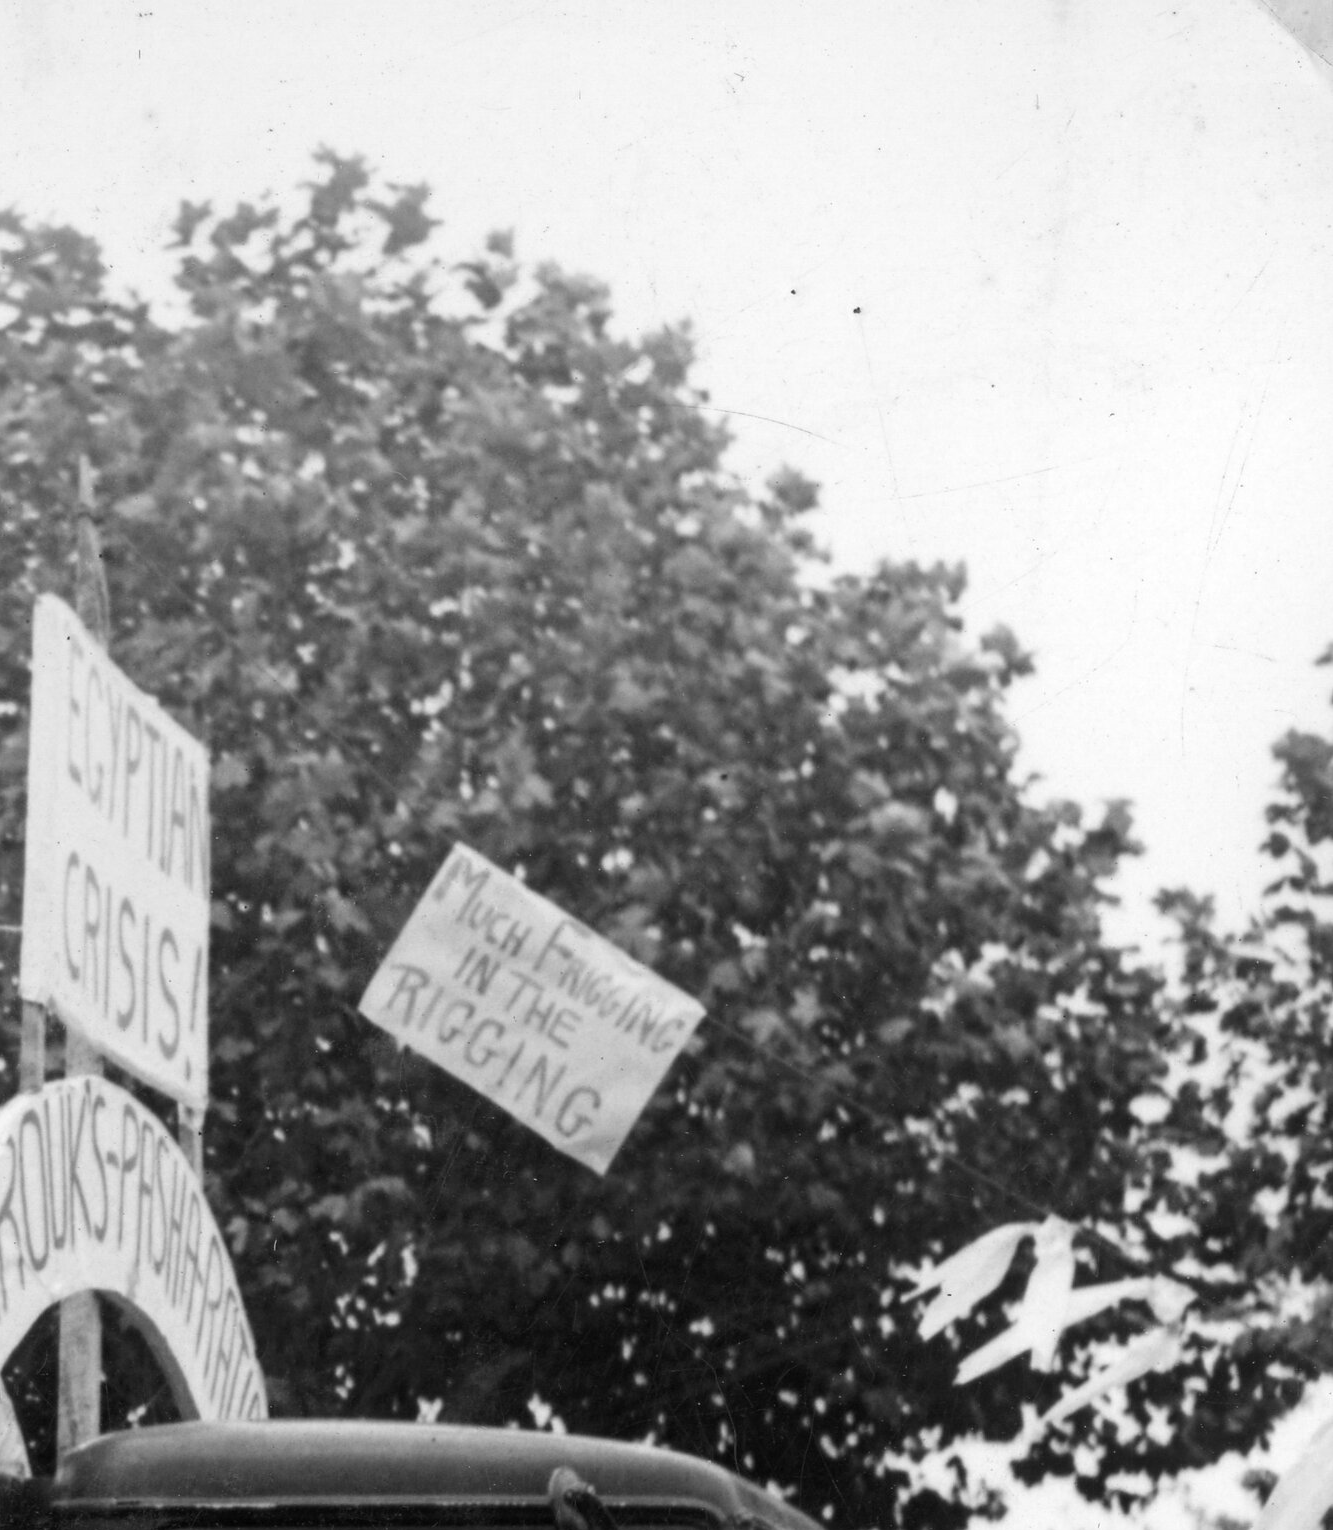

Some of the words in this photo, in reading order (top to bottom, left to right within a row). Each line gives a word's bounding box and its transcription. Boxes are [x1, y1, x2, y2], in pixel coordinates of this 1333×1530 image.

[67, 633, 210, 902] EGYPTIAN
[64, 850, 203, 1082] CRISIS!
[387, 963, 602, 1139] RIGGING
[453, 949, 501, 996] IN
[506, 969, 582, 1050] THE
